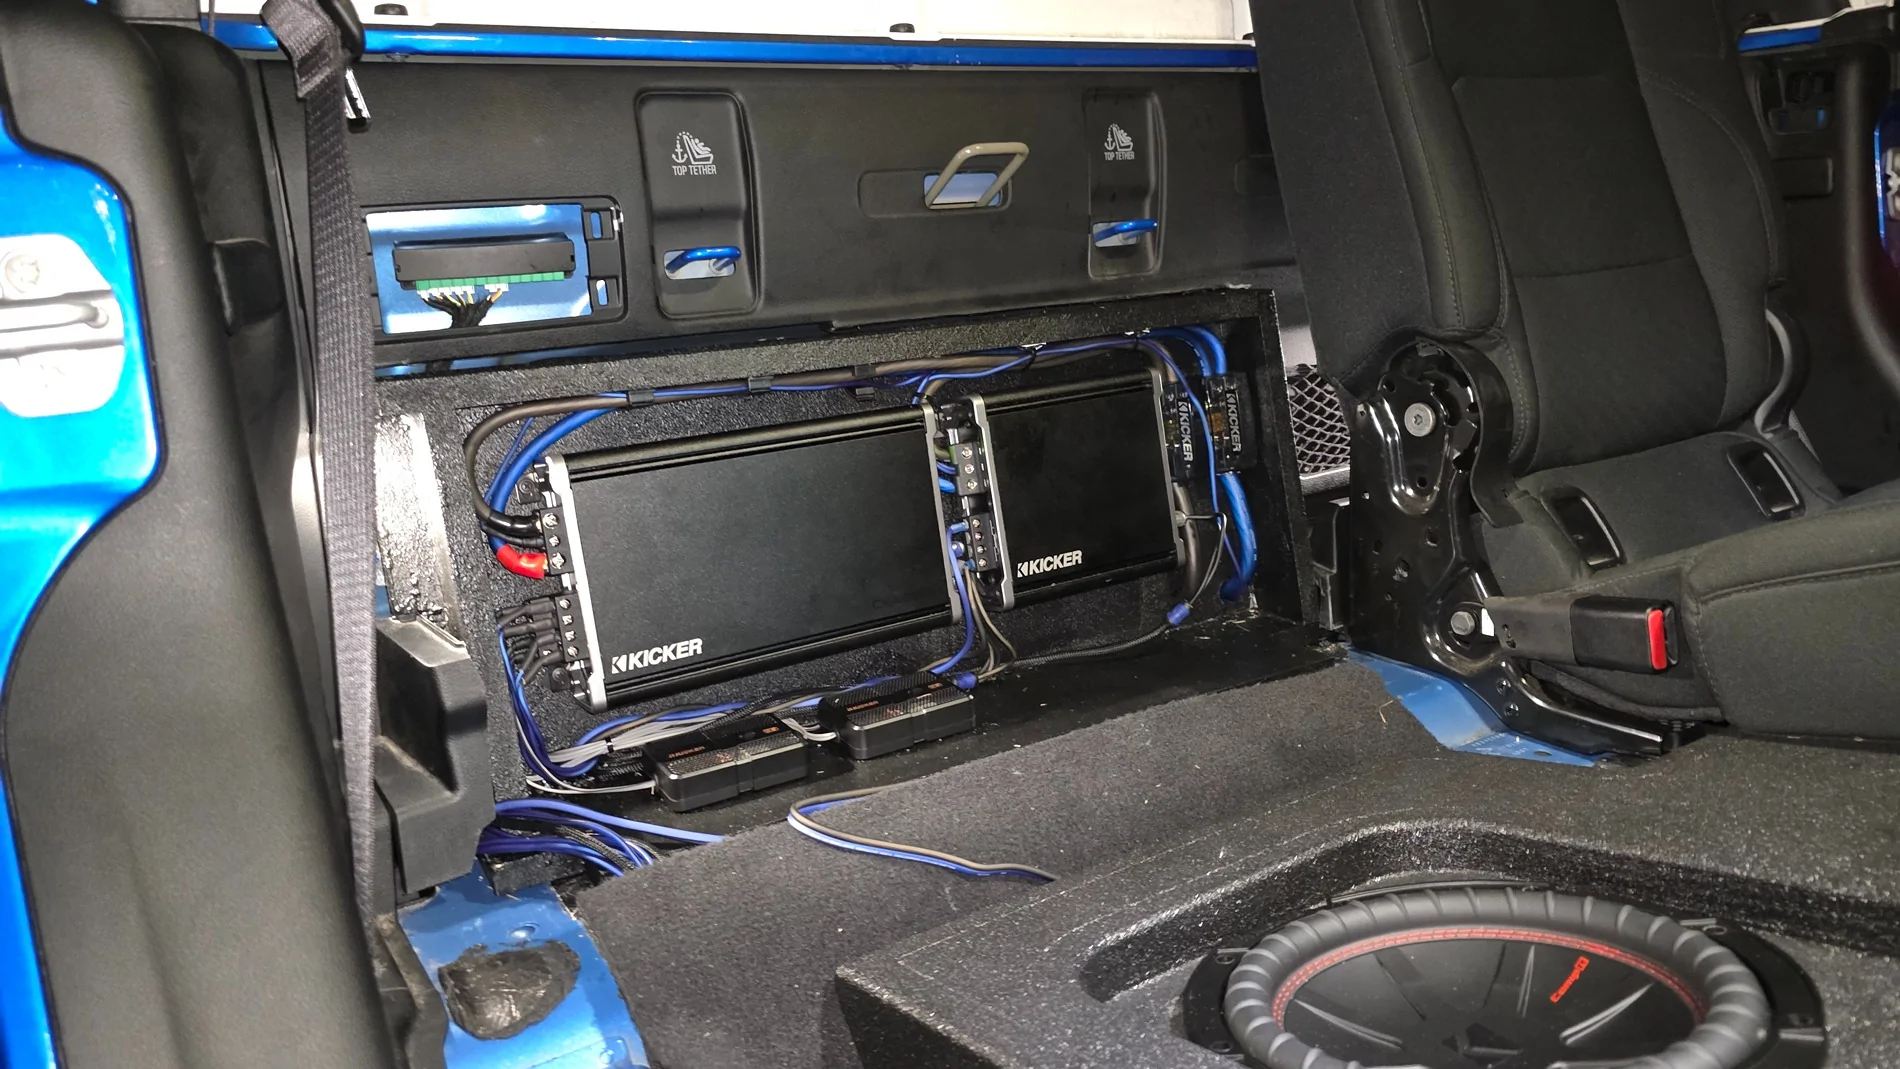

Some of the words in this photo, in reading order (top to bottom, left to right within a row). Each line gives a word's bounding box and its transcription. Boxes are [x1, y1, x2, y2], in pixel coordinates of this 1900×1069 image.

[672, 165, 688, 176] TOP
[688, 164, 718, 176] TETHER
[1104, 152, 1115, 160] TOP
[1115, 151, 1135, 160] TETHER
[1179, 410, 1194, 461] KICKER
[1227, 403, 1242, 452] KICKER
[1029, 550, 1083, 575] KICKER
[628, 638, 703, 671] KICKER
